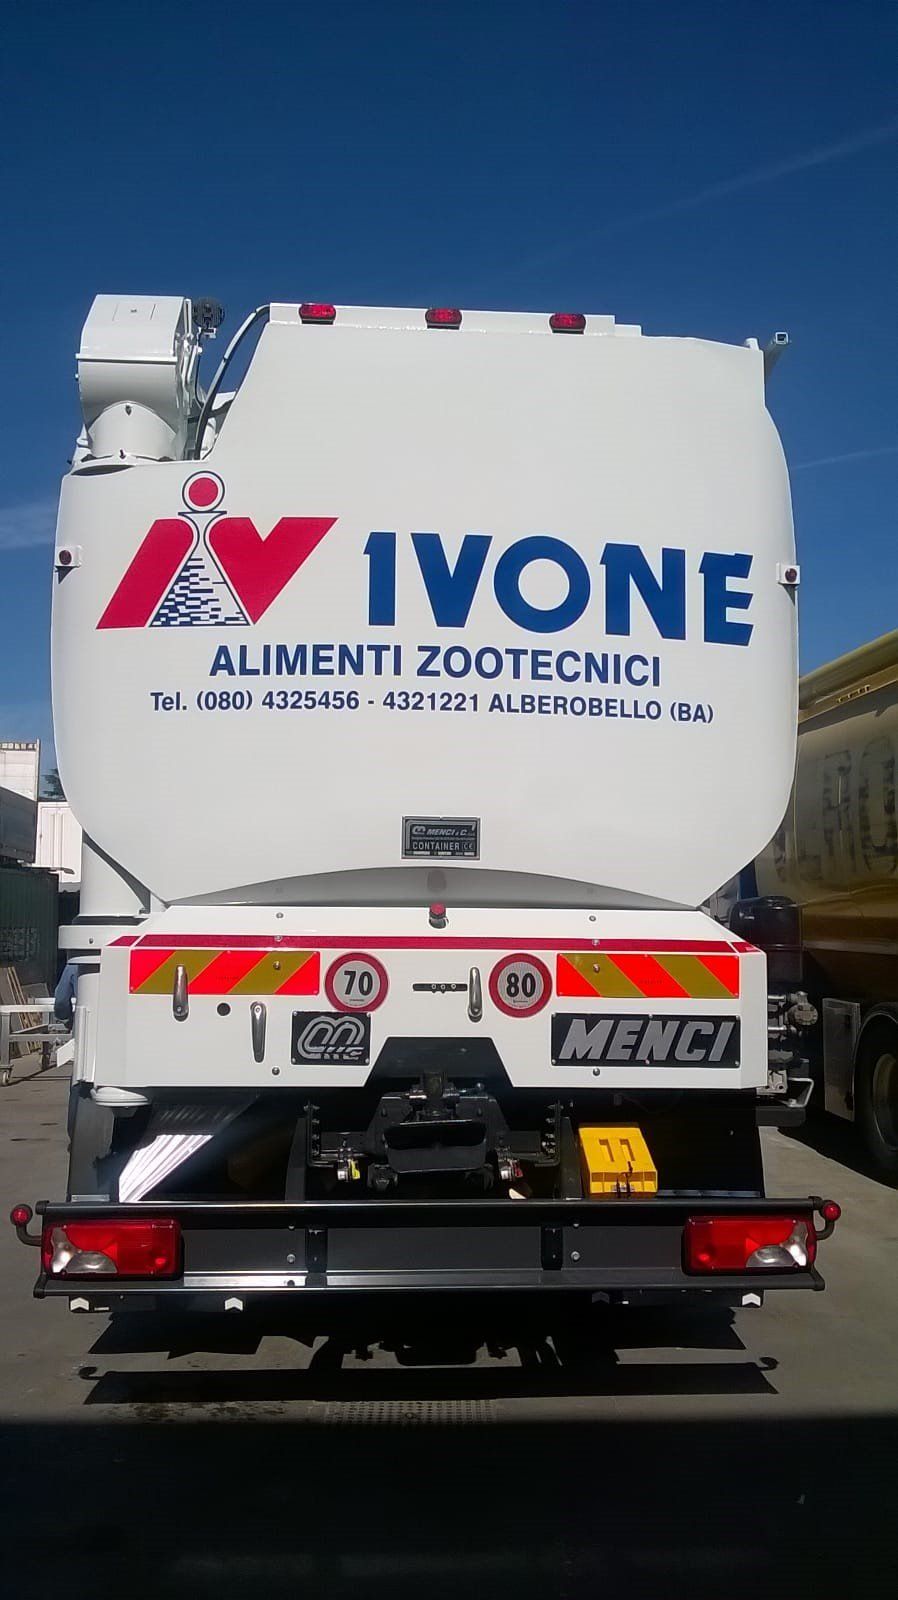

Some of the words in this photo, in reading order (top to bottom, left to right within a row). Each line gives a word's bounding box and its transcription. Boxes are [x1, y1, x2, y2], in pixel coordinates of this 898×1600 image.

[363, 531, 754, 647] IVONE
[209, 643, 402, 677] ALIMENTI
[416, 645, 661, 687] ZOOTECNICI
[150, 691, 187, 711] Tel.
[196, 690, 253, 712] (080)
[261, 690, 360, 710] 4325456
[382, 691, 478, 712] 4321221
[488, 693, 662, 720] ALBEROBELLO
[670, 702, 714, 724] (BA)
[412, 841, 460, 851] CONTAINER
[426, 828, 456, 836] MENCI
[343, 970, 373, 996] 70
[506, 972, 536, 998] 80
[558, 1018, 735, 1061] MENCI
